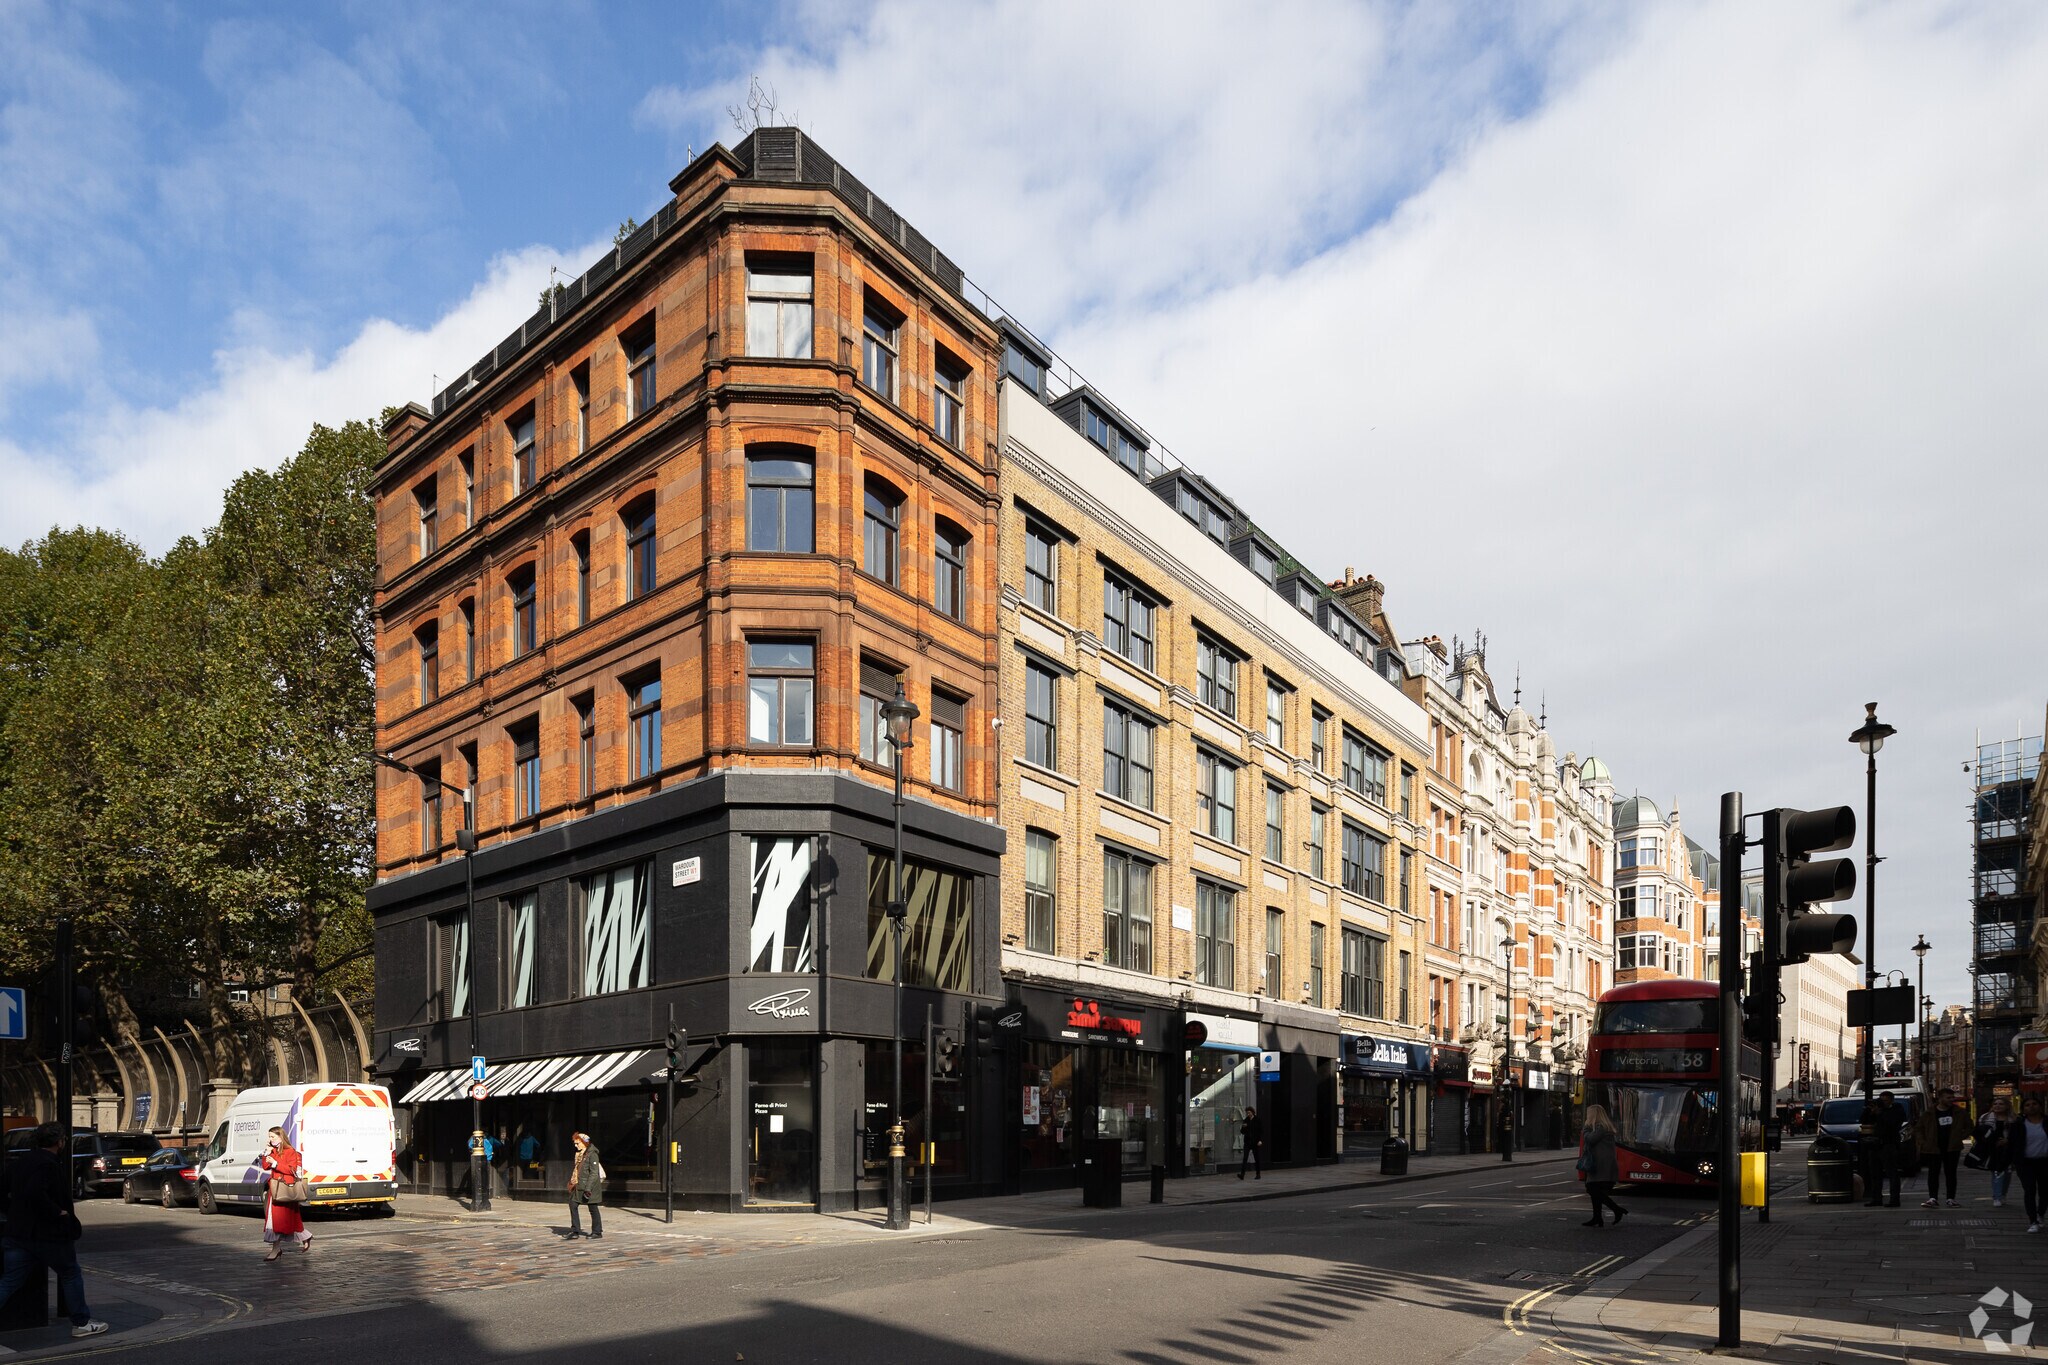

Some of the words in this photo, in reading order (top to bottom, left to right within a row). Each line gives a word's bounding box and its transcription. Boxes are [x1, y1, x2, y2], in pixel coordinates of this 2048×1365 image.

[675, 861, 695, 871] WARDOUR
[675, 869, 690, 878] STREET
[748, 988, 811, 1018] Princi
[1372, 1044, 1390, 1062] Bella
[1390, 1045, 1408, 1064] Italia
[1619, 1056, 1659, 1065] Victoria
[1681, 1053, 1703, 1067] 38
[1800, 1045, 1808, 1091] CURZON
[474, 1088, 486, 1096] 20
[234, 1120, 260, 1133] openreach
[307, 1127, 347, 1136] openreach
